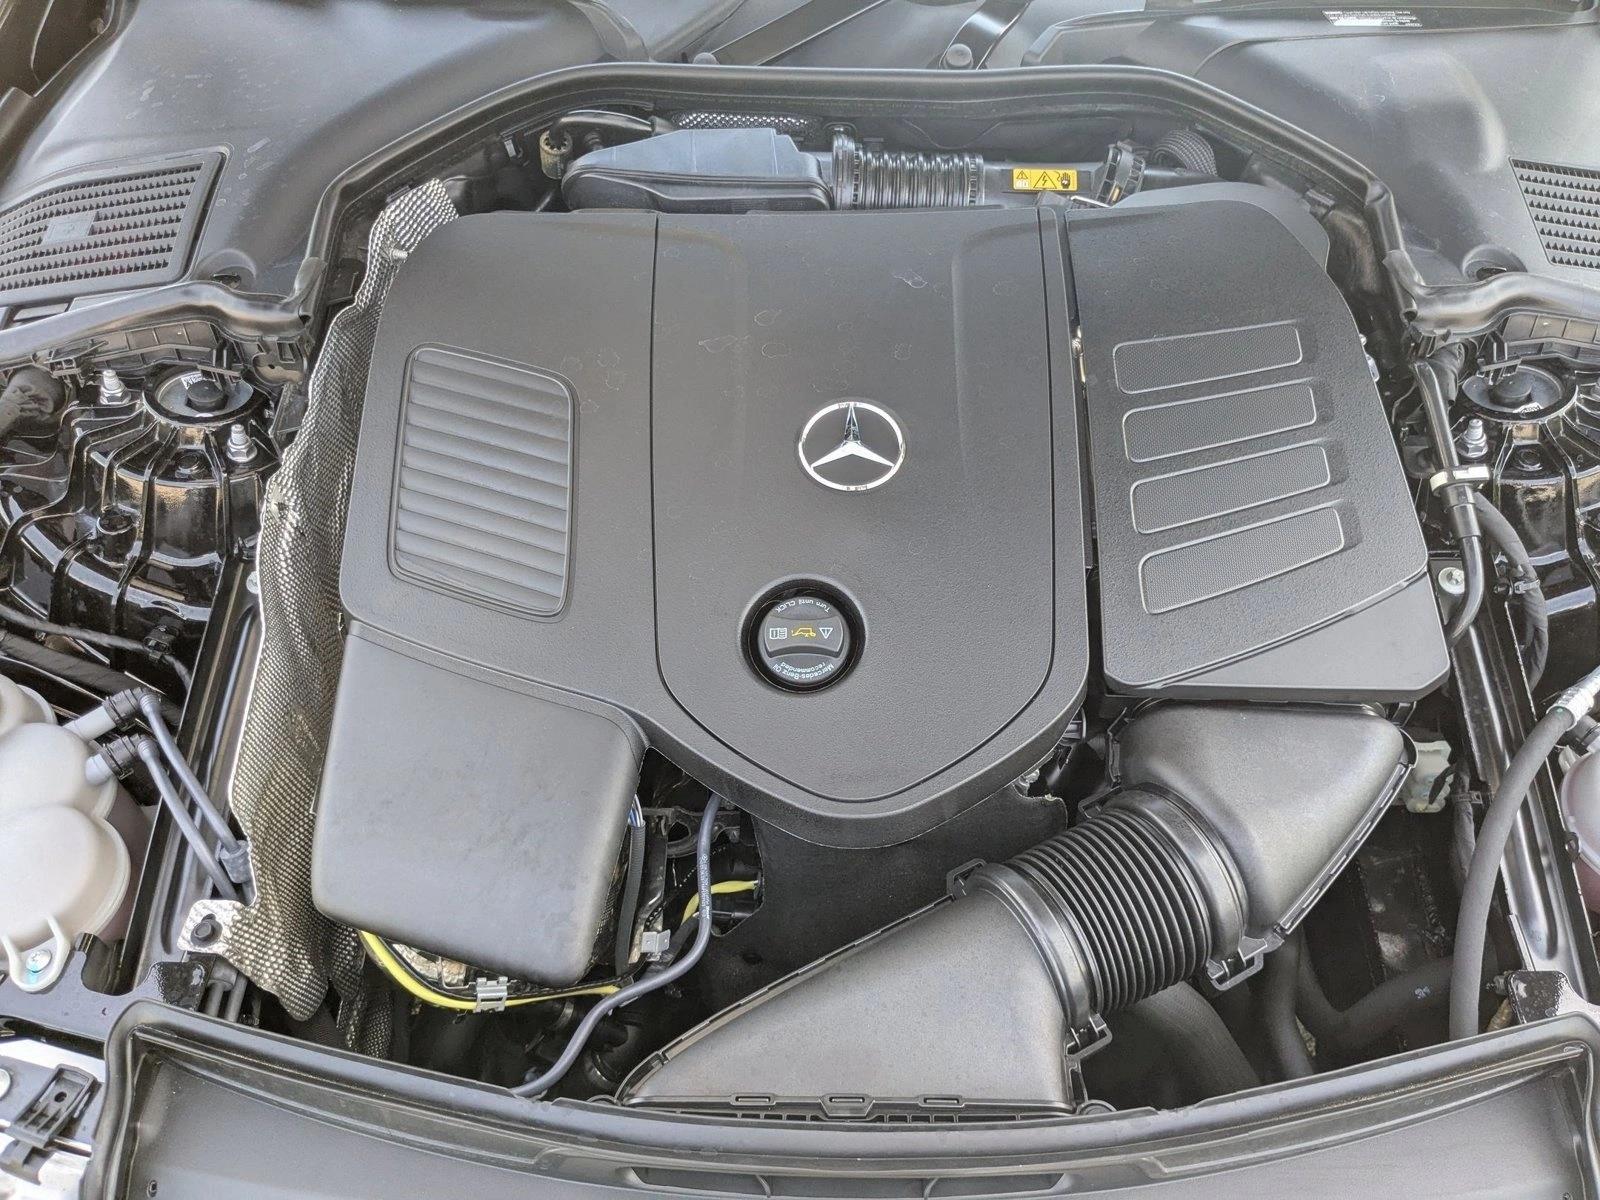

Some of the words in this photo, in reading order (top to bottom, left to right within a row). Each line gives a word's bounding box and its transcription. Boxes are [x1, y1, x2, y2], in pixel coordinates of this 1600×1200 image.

[775, 600, 796, 614] CLICK
[816, 601, 831, 613] Turn
[772, 663, 782, 673] Oil
[781, 661, 826, 673] recommended
[782, 663, 835, 680] Mercedes-Benz
